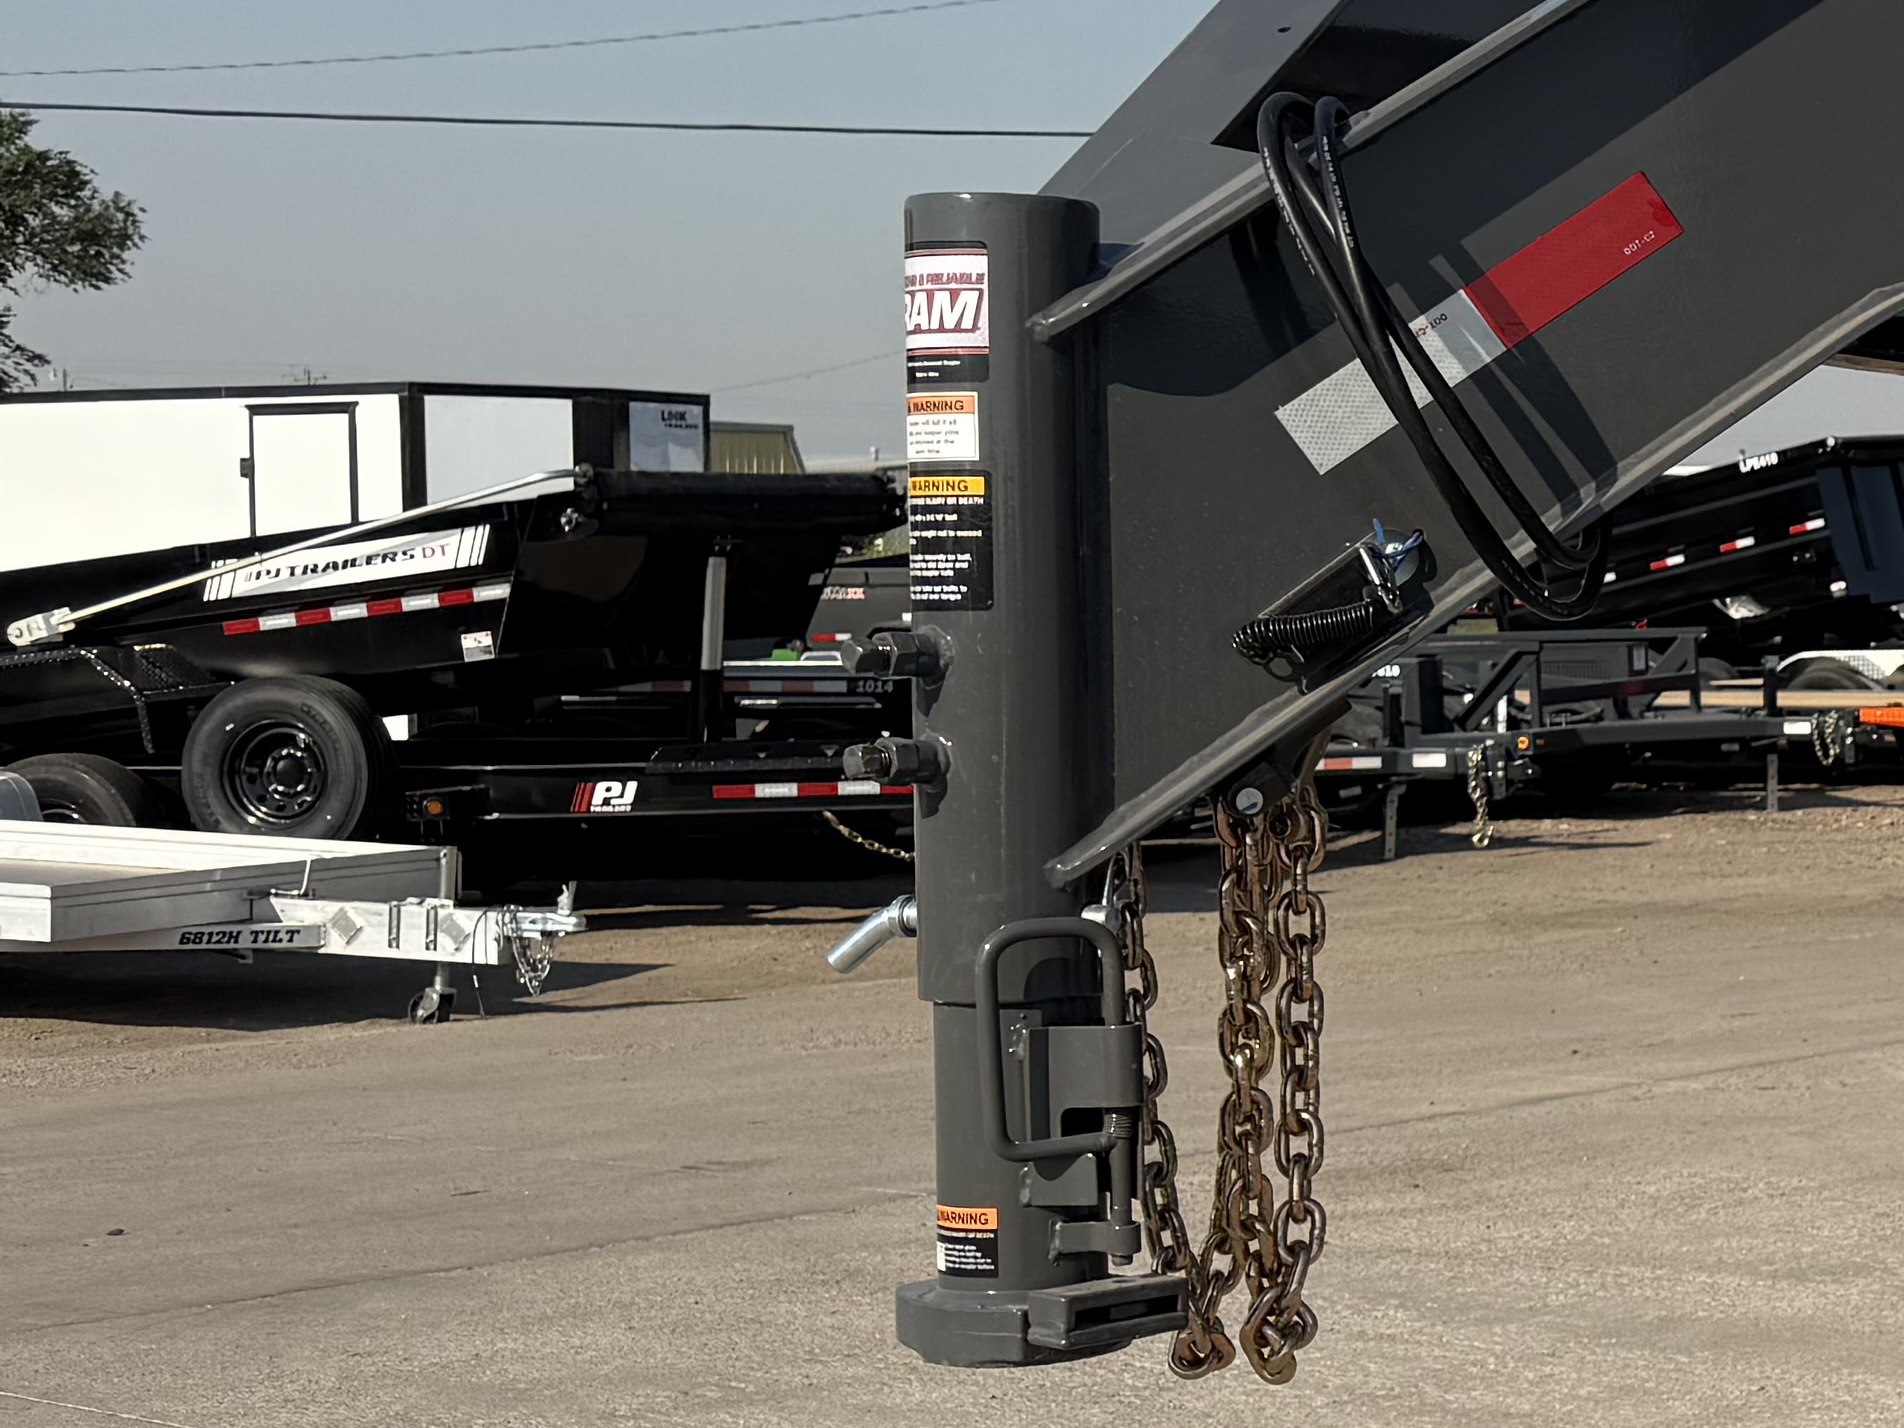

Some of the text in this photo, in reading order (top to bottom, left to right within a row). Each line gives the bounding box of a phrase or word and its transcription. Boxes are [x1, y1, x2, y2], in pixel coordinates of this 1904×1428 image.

[912, 400, 964, 413] WARNING
[911, 479, 969, 492] WARNING
[421, 542, 451, 560] DT
[591, 780, 639, 806] PJ
[178, 929, 301, 946] 6812H TILT
[940, 1210, 989, 1226] WARNING
